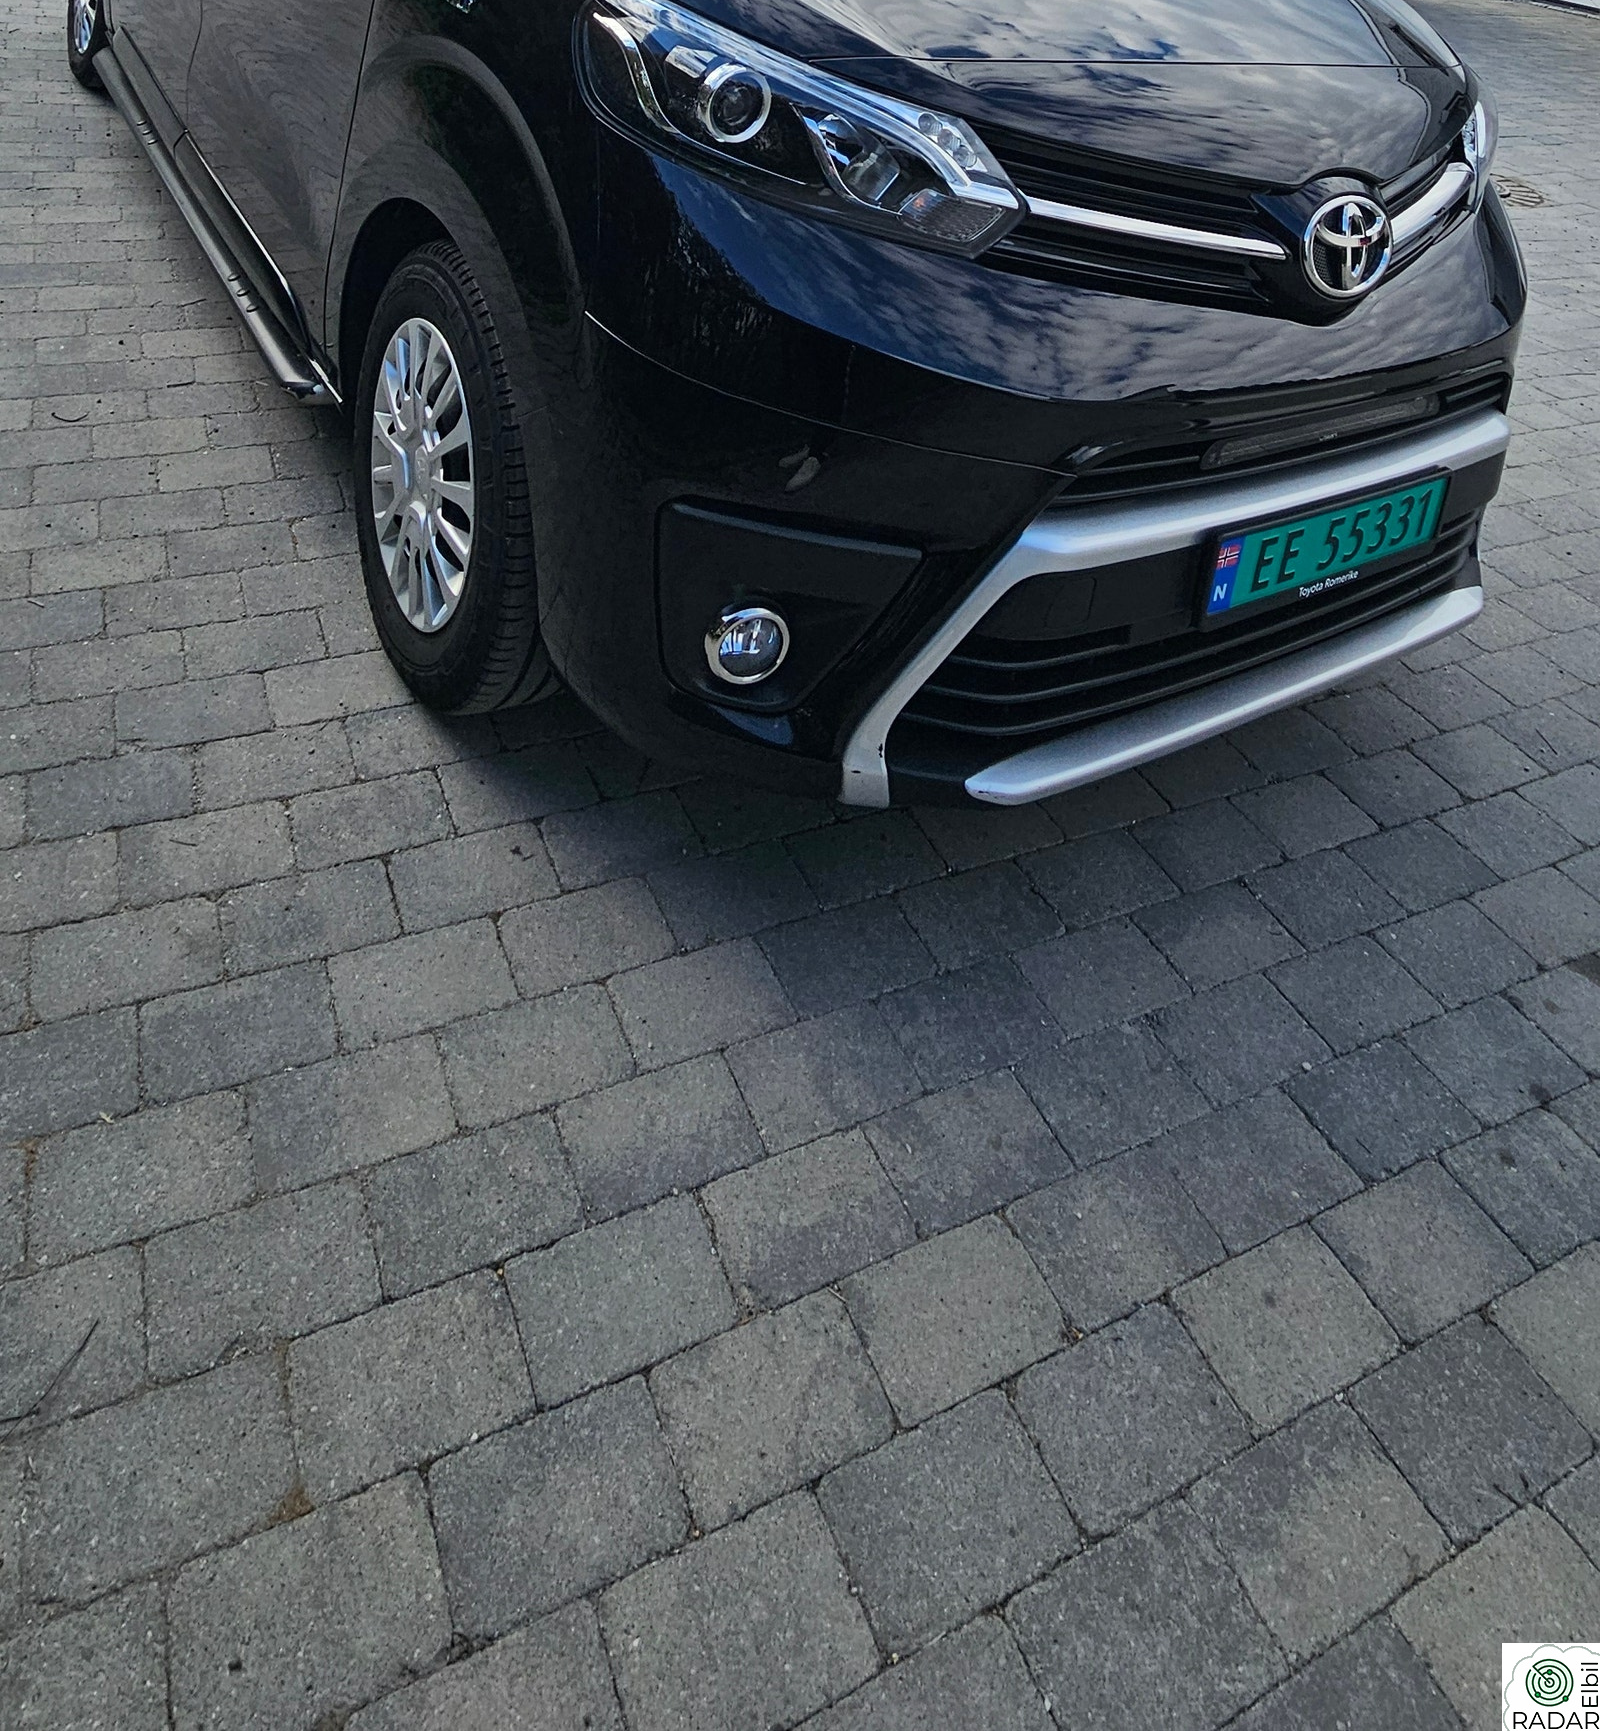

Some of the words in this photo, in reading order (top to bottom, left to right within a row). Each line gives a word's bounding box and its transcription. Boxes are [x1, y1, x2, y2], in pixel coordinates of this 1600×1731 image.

[1251, 529, 1305, 592] EE
[1316, 488, 1434, 571] 55331
[1213, 583, 1228, 602] N
[1299, 582, 1323, 598] Toyota
